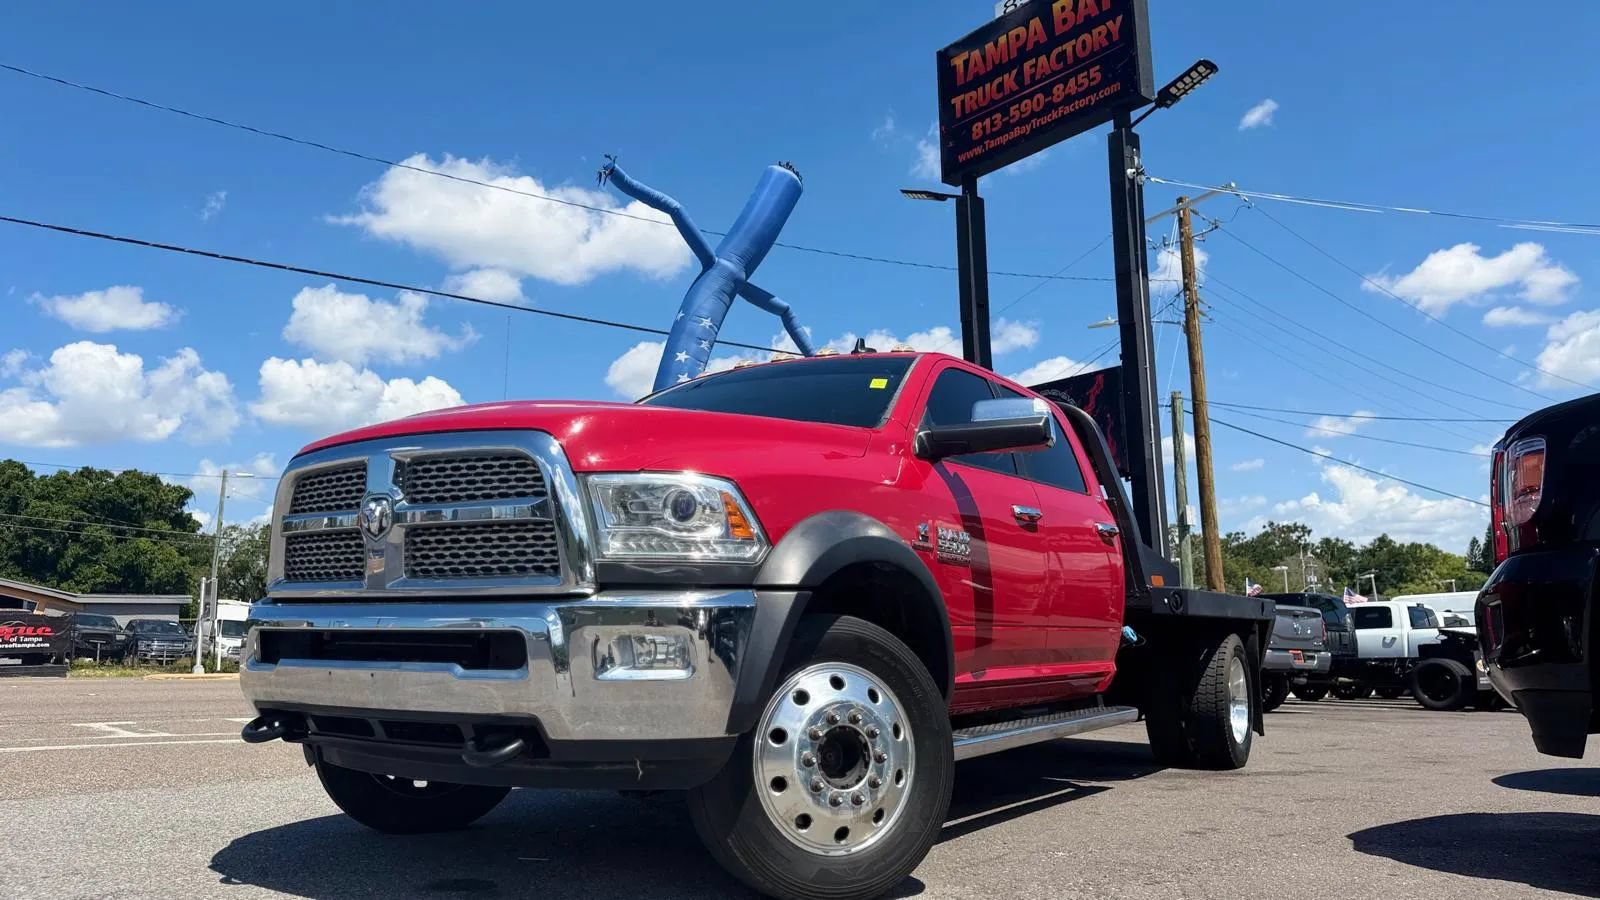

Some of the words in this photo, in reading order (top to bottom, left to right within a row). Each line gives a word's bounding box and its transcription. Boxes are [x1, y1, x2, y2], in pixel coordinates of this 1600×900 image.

[951, 17, 1048, 86] TAMPA
[952, 69, 1020, 119] TRUCK
[1023, 14, 1123, 85] FACTORY
[958, 81, 1121, 163] www.TampaBayTruckFactory.com
[971, 65, 1102, 141] 813-590-8455
